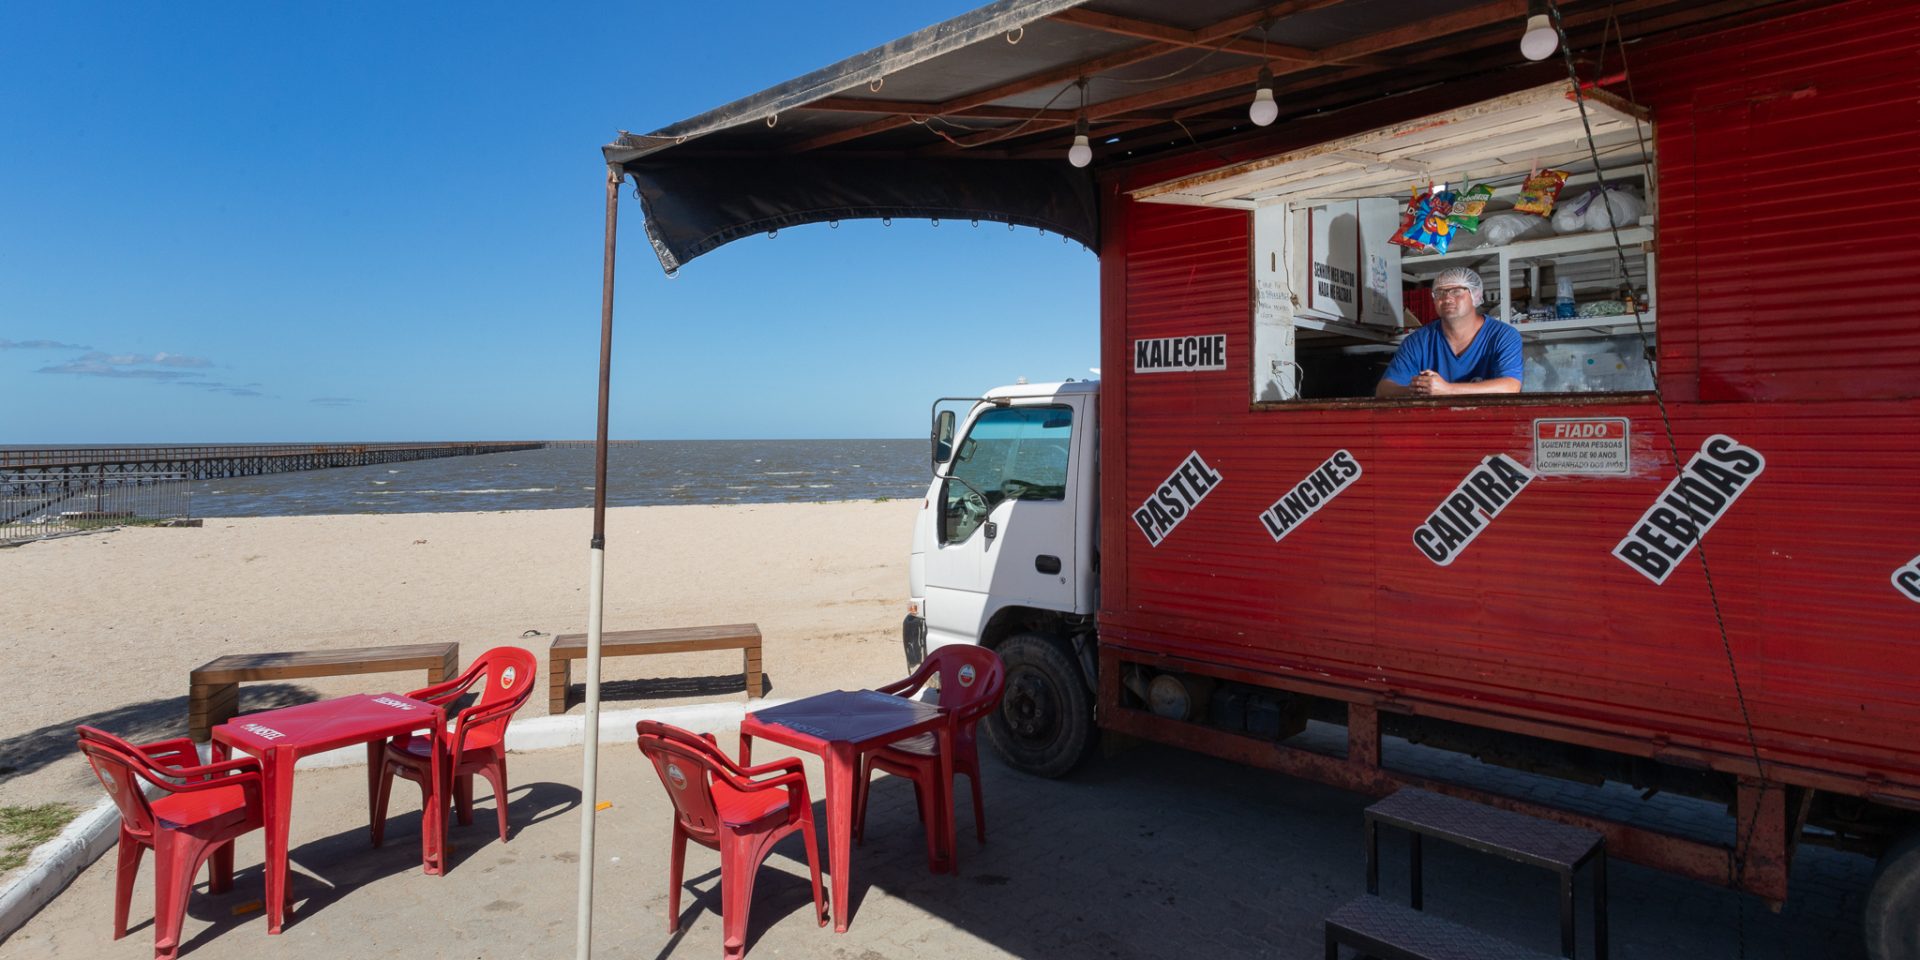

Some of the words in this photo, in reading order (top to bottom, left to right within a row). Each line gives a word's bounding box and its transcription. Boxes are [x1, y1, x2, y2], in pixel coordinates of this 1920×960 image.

[1136, 336, 1225, 368] KALECHE
[1546, 451, 1561, 459] COM
[1562, 451, 1578, 459] MAIS
[1579, 451, 1588, 459] DE
[1598, 451, 1617, 459] ANOS
[1554, 423, 1607, 438] FIADO
[1572, 441, 1590, 449] PARA
[1591, 441, 1623, 449] PESSOAS
[1136, 455, 1220, 543] PASTEL
[1262, 451, 1358, 538] LANCHES
[1414, 456, 1530, 563] CAIPIRA
[1619, 438, 1760, 579] BEBIDAS
